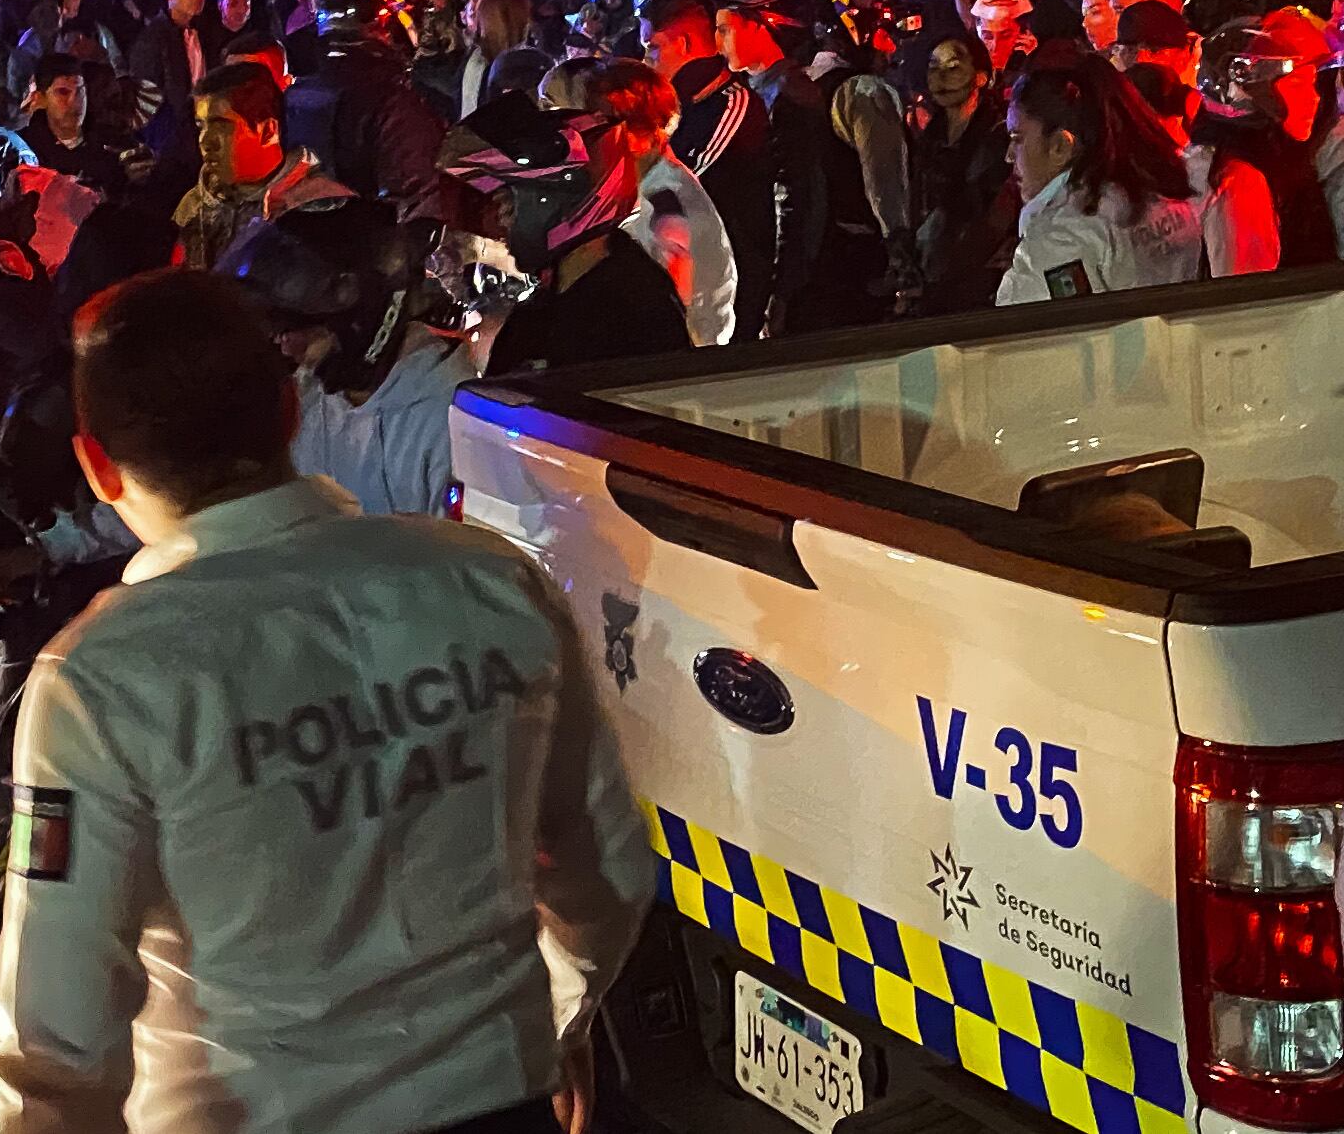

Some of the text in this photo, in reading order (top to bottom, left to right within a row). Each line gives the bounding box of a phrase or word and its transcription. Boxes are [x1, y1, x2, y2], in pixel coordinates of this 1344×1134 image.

[298, 732, 486, 832] VIAL
[916, 694, 1083, 849] V-35
[998, 918, 1133, 997] de Seguridad
